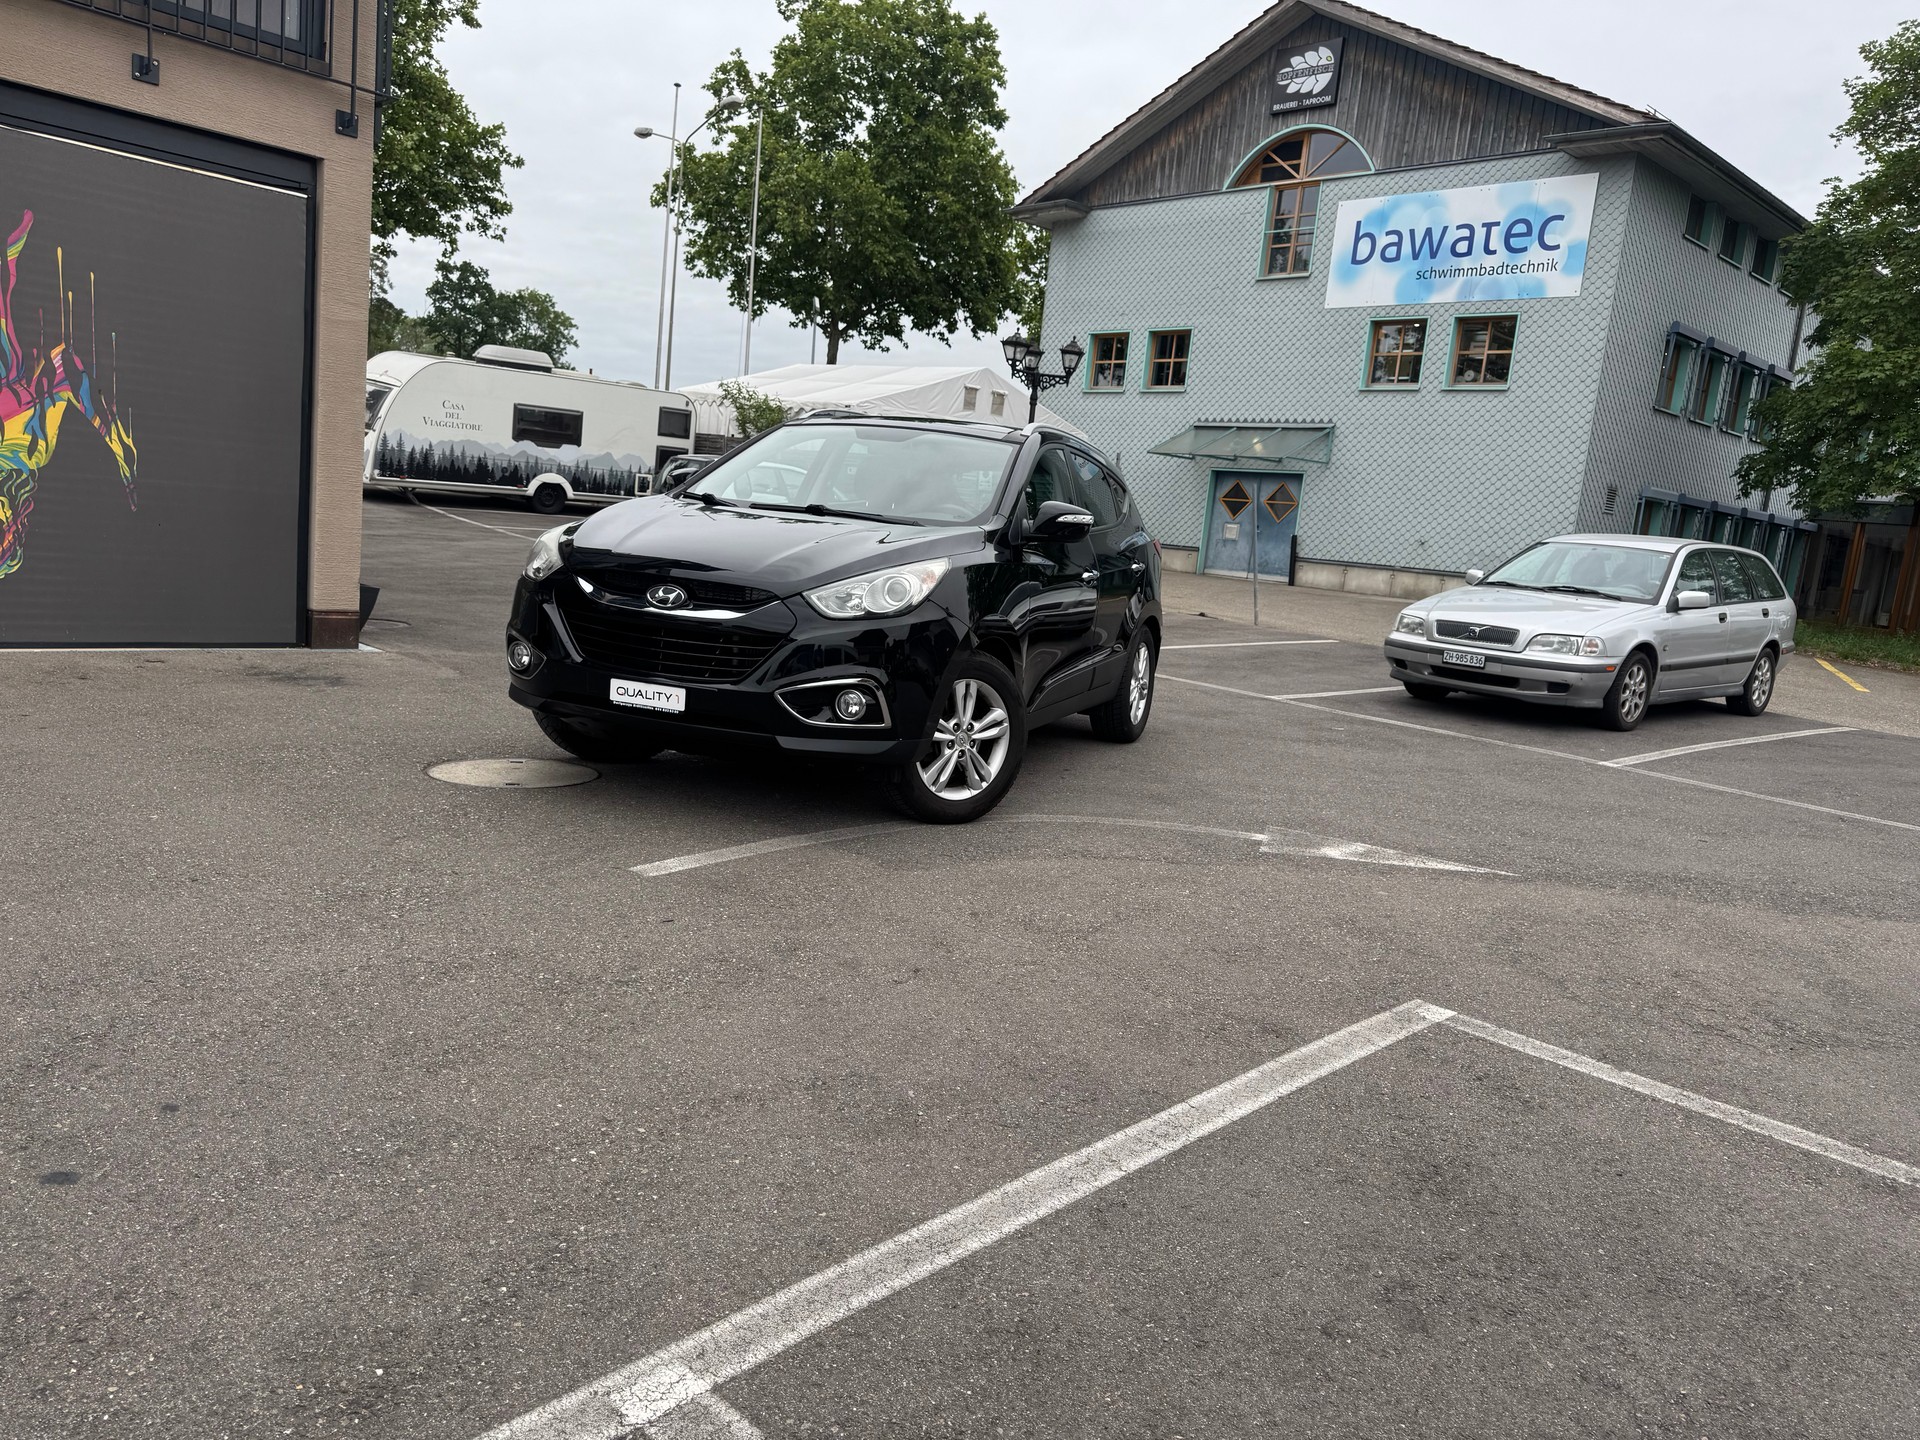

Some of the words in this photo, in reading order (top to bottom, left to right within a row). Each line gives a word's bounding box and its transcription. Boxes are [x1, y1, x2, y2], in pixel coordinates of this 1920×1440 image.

[1276, 64, 1335, 81] HOPFENFISCH
[1272, 100, 1299, 111] BRAUEREI
[1302, 95, 1332, 106] TAPROOM
[1350, 213, 1566, 266] bawatec
[1415, 257, 1559, 281] schwimmbadtechnik
[1444, 651, 1454, 661] ZH
[616, 686, 673, 703] QUALITY
